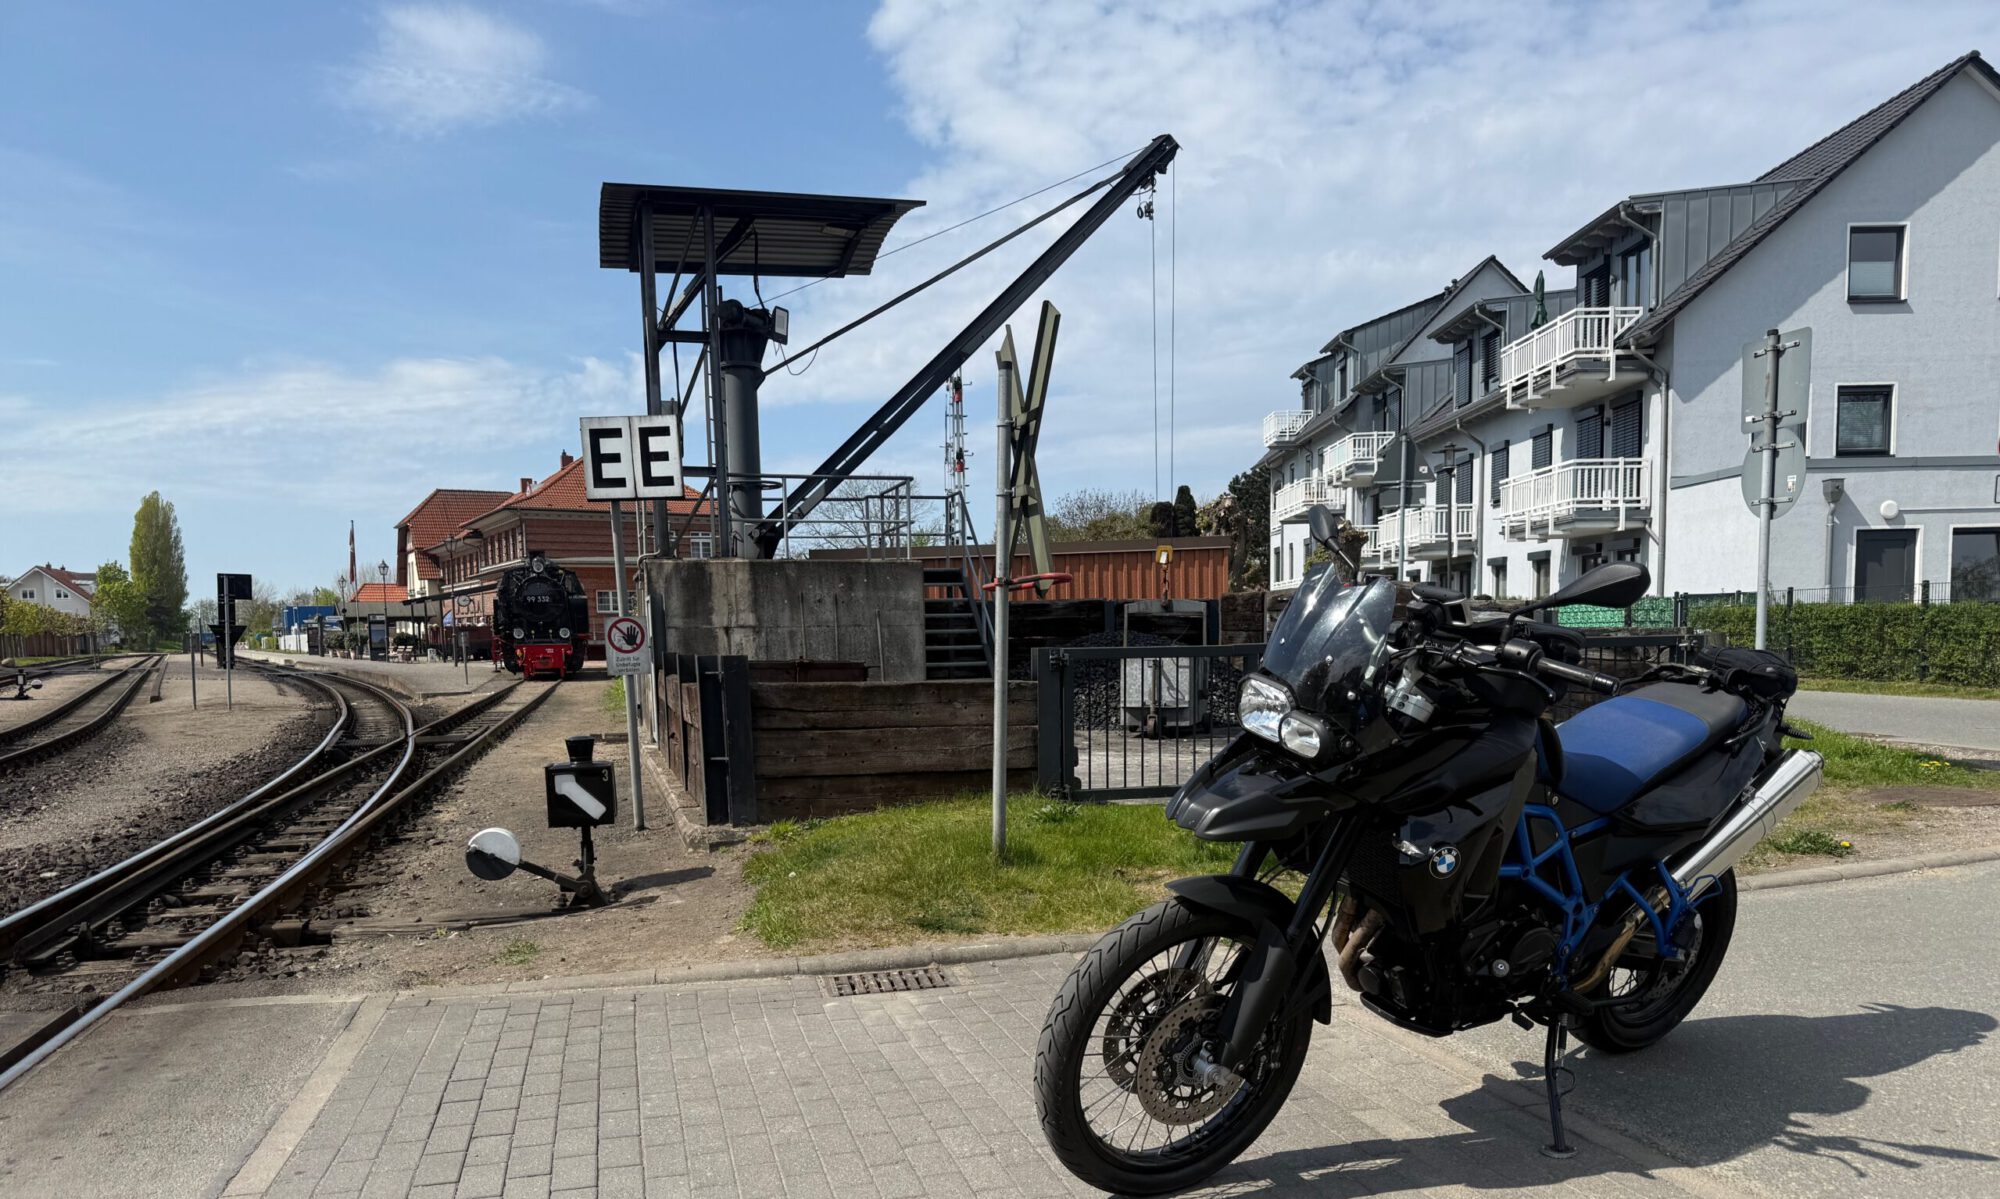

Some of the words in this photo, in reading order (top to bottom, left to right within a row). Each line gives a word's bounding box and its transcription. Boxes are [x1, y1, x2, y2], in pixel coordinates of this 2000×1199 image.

[526, 595, 536, 603] 99
[537, 595, 550, 603] 332
[601, 769, 609, 782] 3
[1433, 849, 1458, 863] BMW
